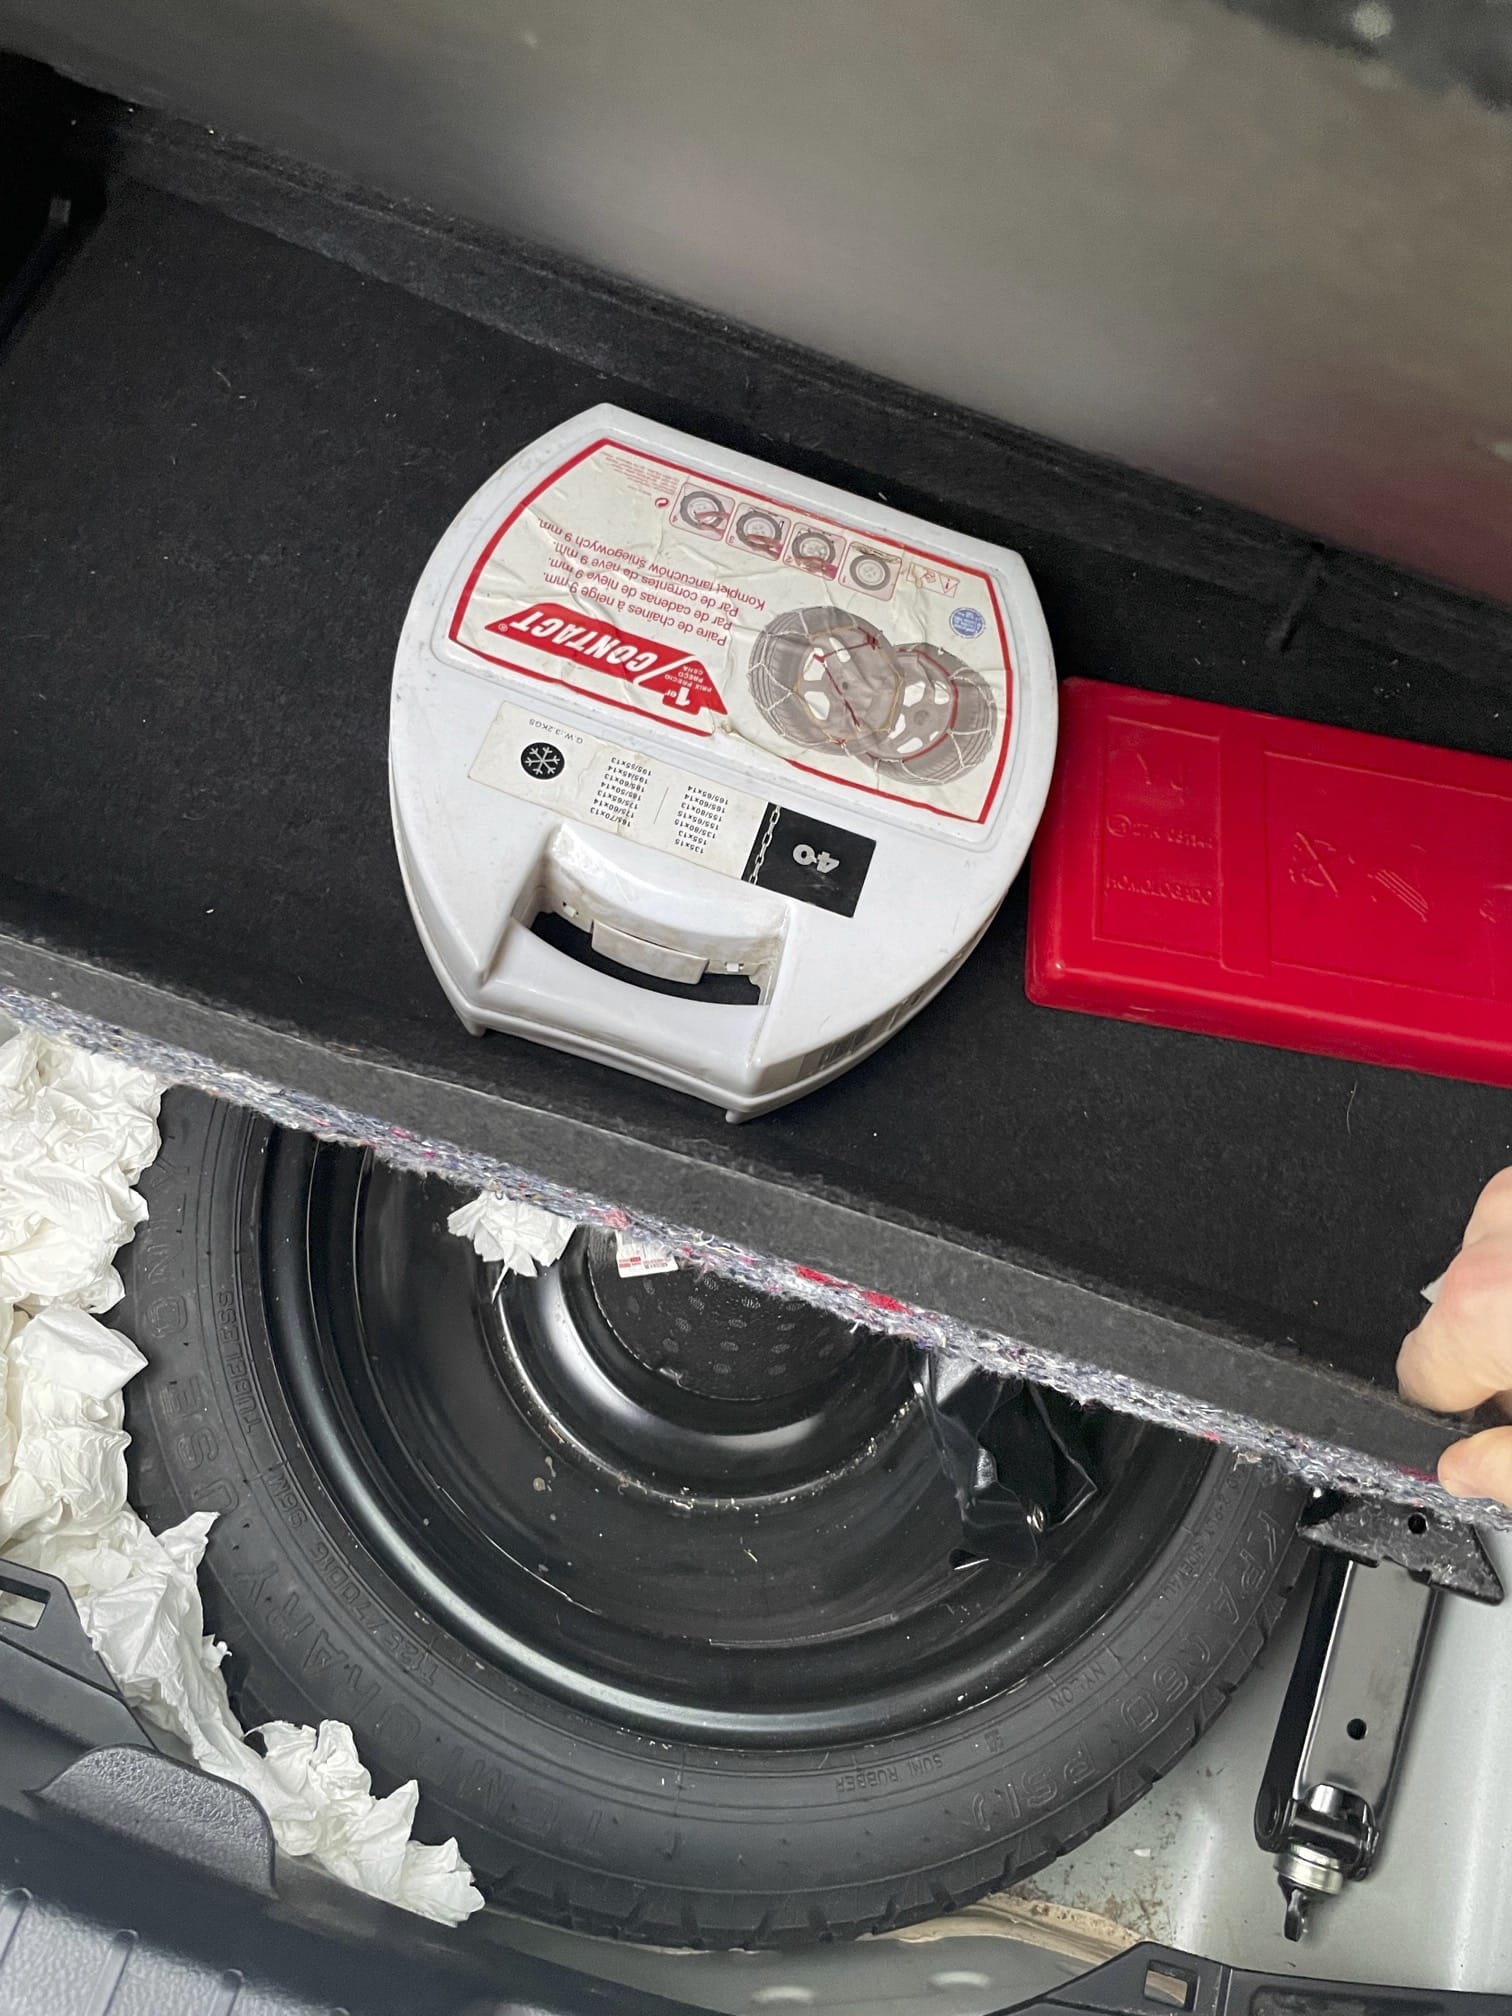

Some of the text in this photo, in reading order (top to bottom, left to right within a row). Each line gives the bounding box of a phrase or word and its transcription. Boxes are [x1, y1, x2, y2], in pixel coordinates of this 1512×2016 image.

[535, 517, 562, 535] mm.
[563, 531, 572, 542] 9
[551, 541, 578, 558] mm.
[579, 554, 589, 565] 9
[590, 557, 621, 572] neve
[546, 556, 732, 631] Par de cadenas de nieve 9 mm.
[639, 574, 698, 601] correntes
[715, 583, 765, 611] Komplet
[541, 571, 727, 646] Paire de chaînes à neige 9 mm.
[698, 594, 716, 609] de
[716, 600, 739, 617] Par
[508, 607, 657, 673] CONTACT
[663, 673, 692, 687] PRECIO
[674, 838, 704, 853] 135x15
[216, 1290, 264, 1433] TUBELESS
[157, 1374, 244, 1524] USE
[1044, 1660, 1108, 1712] NYLON
[830, 1764, 901, 1794] RUBBER
